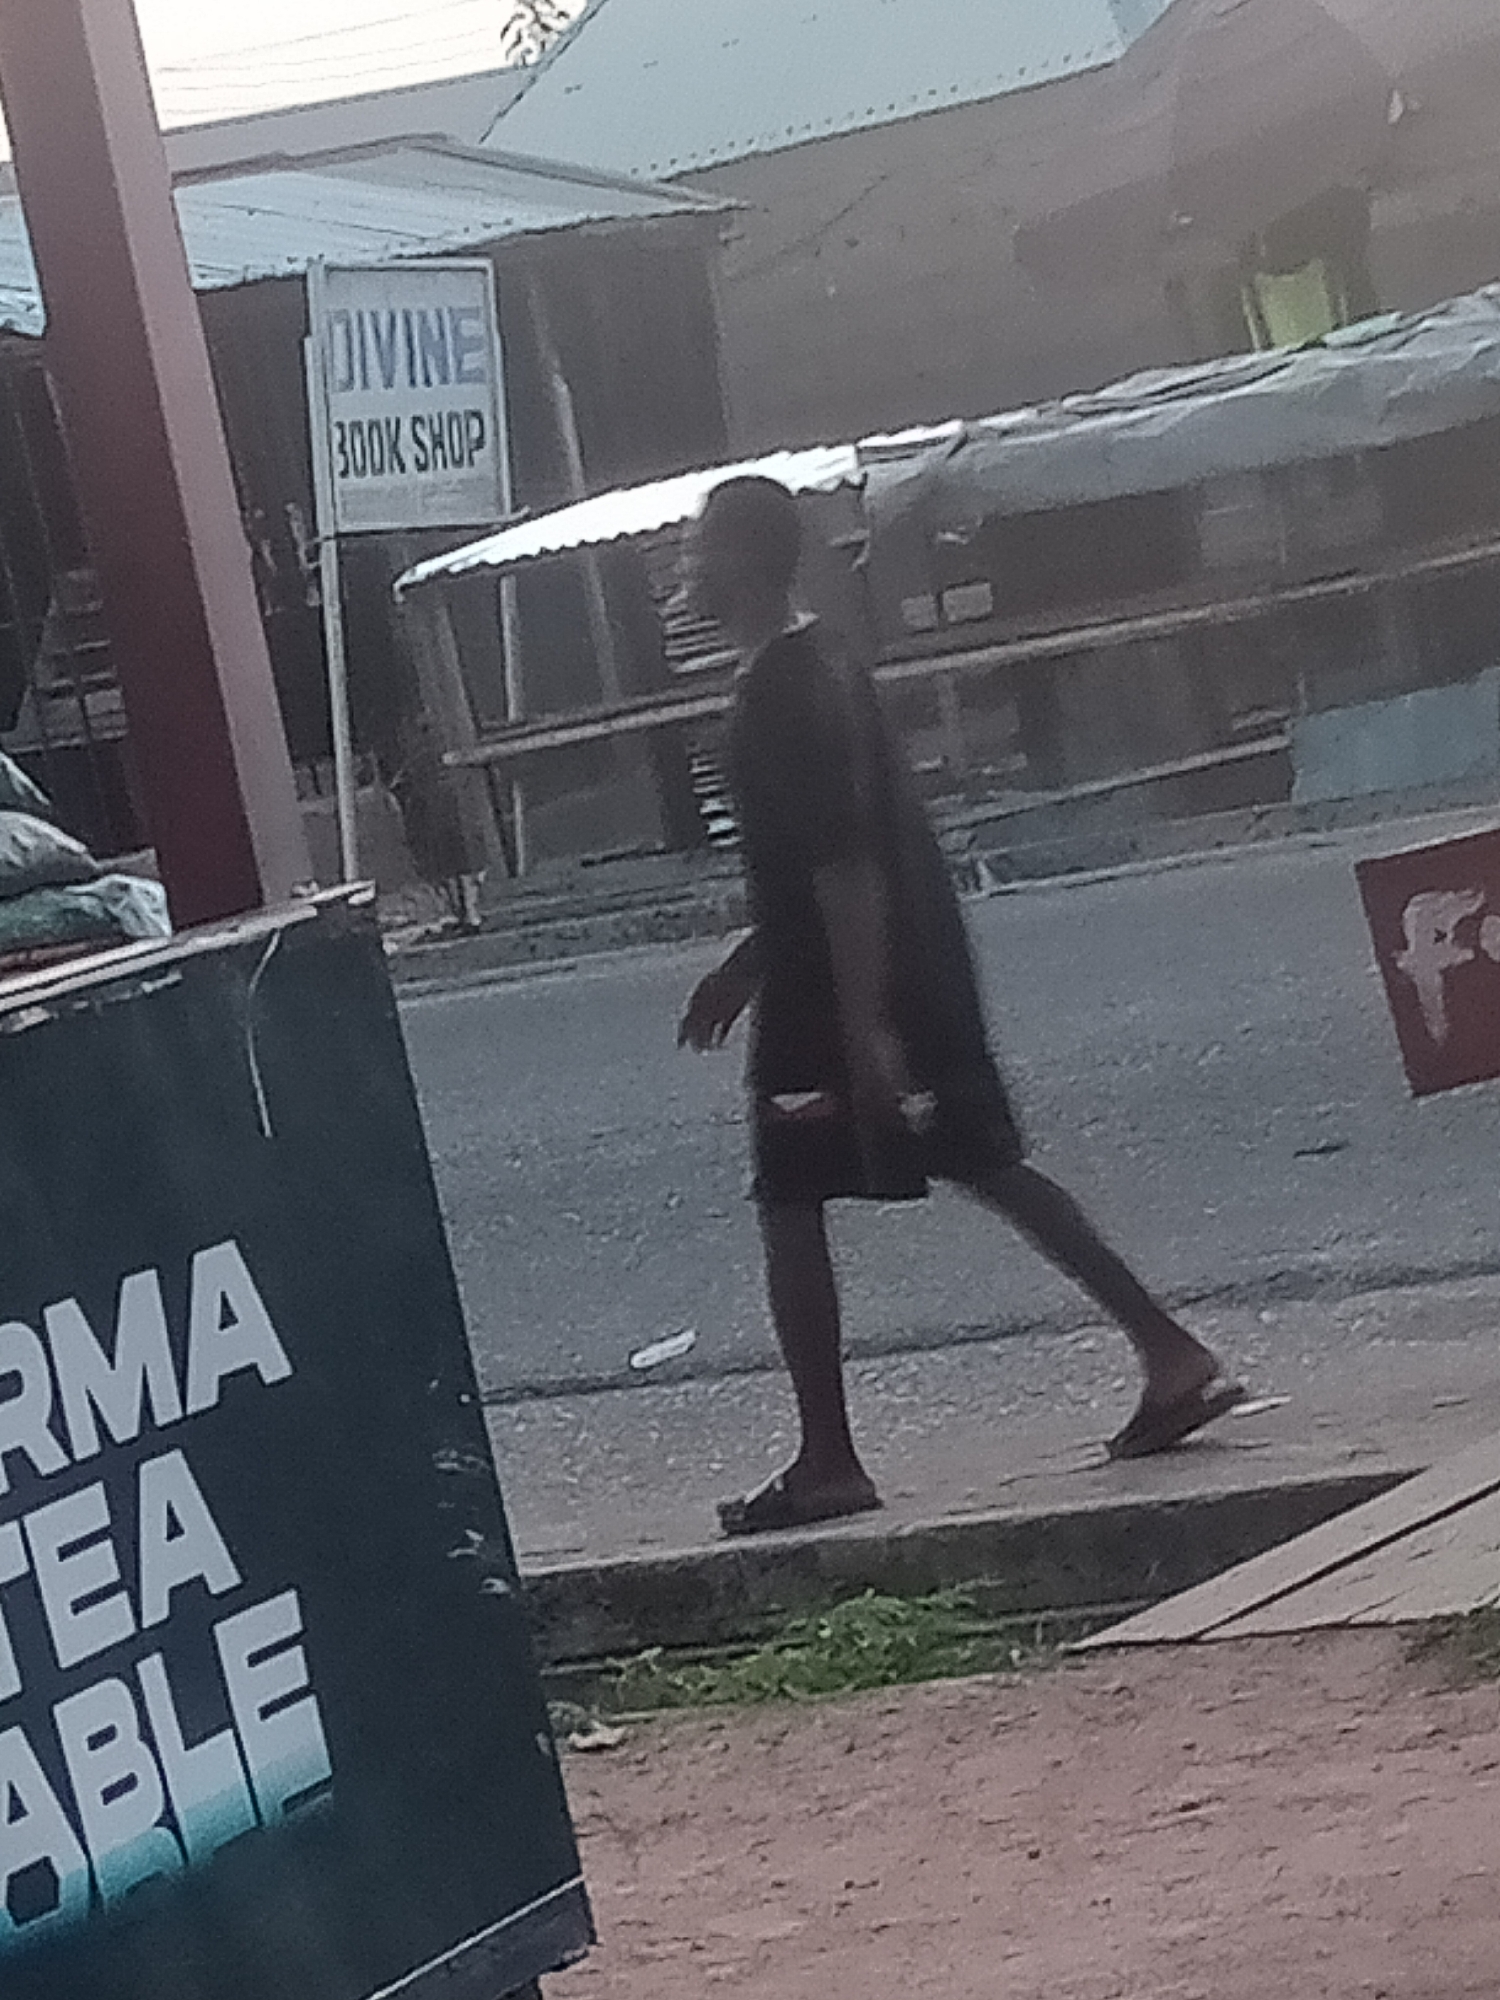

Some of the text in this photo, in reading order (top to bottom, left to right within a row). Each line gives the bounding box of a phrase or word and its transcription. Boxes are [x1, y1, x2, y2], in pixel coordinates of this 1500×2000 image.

[326, 306, 488, 392] DIVINE
[334, 409, 485, 479] BOOK SHOP
[0, 1239, 293, 1496] RMA
